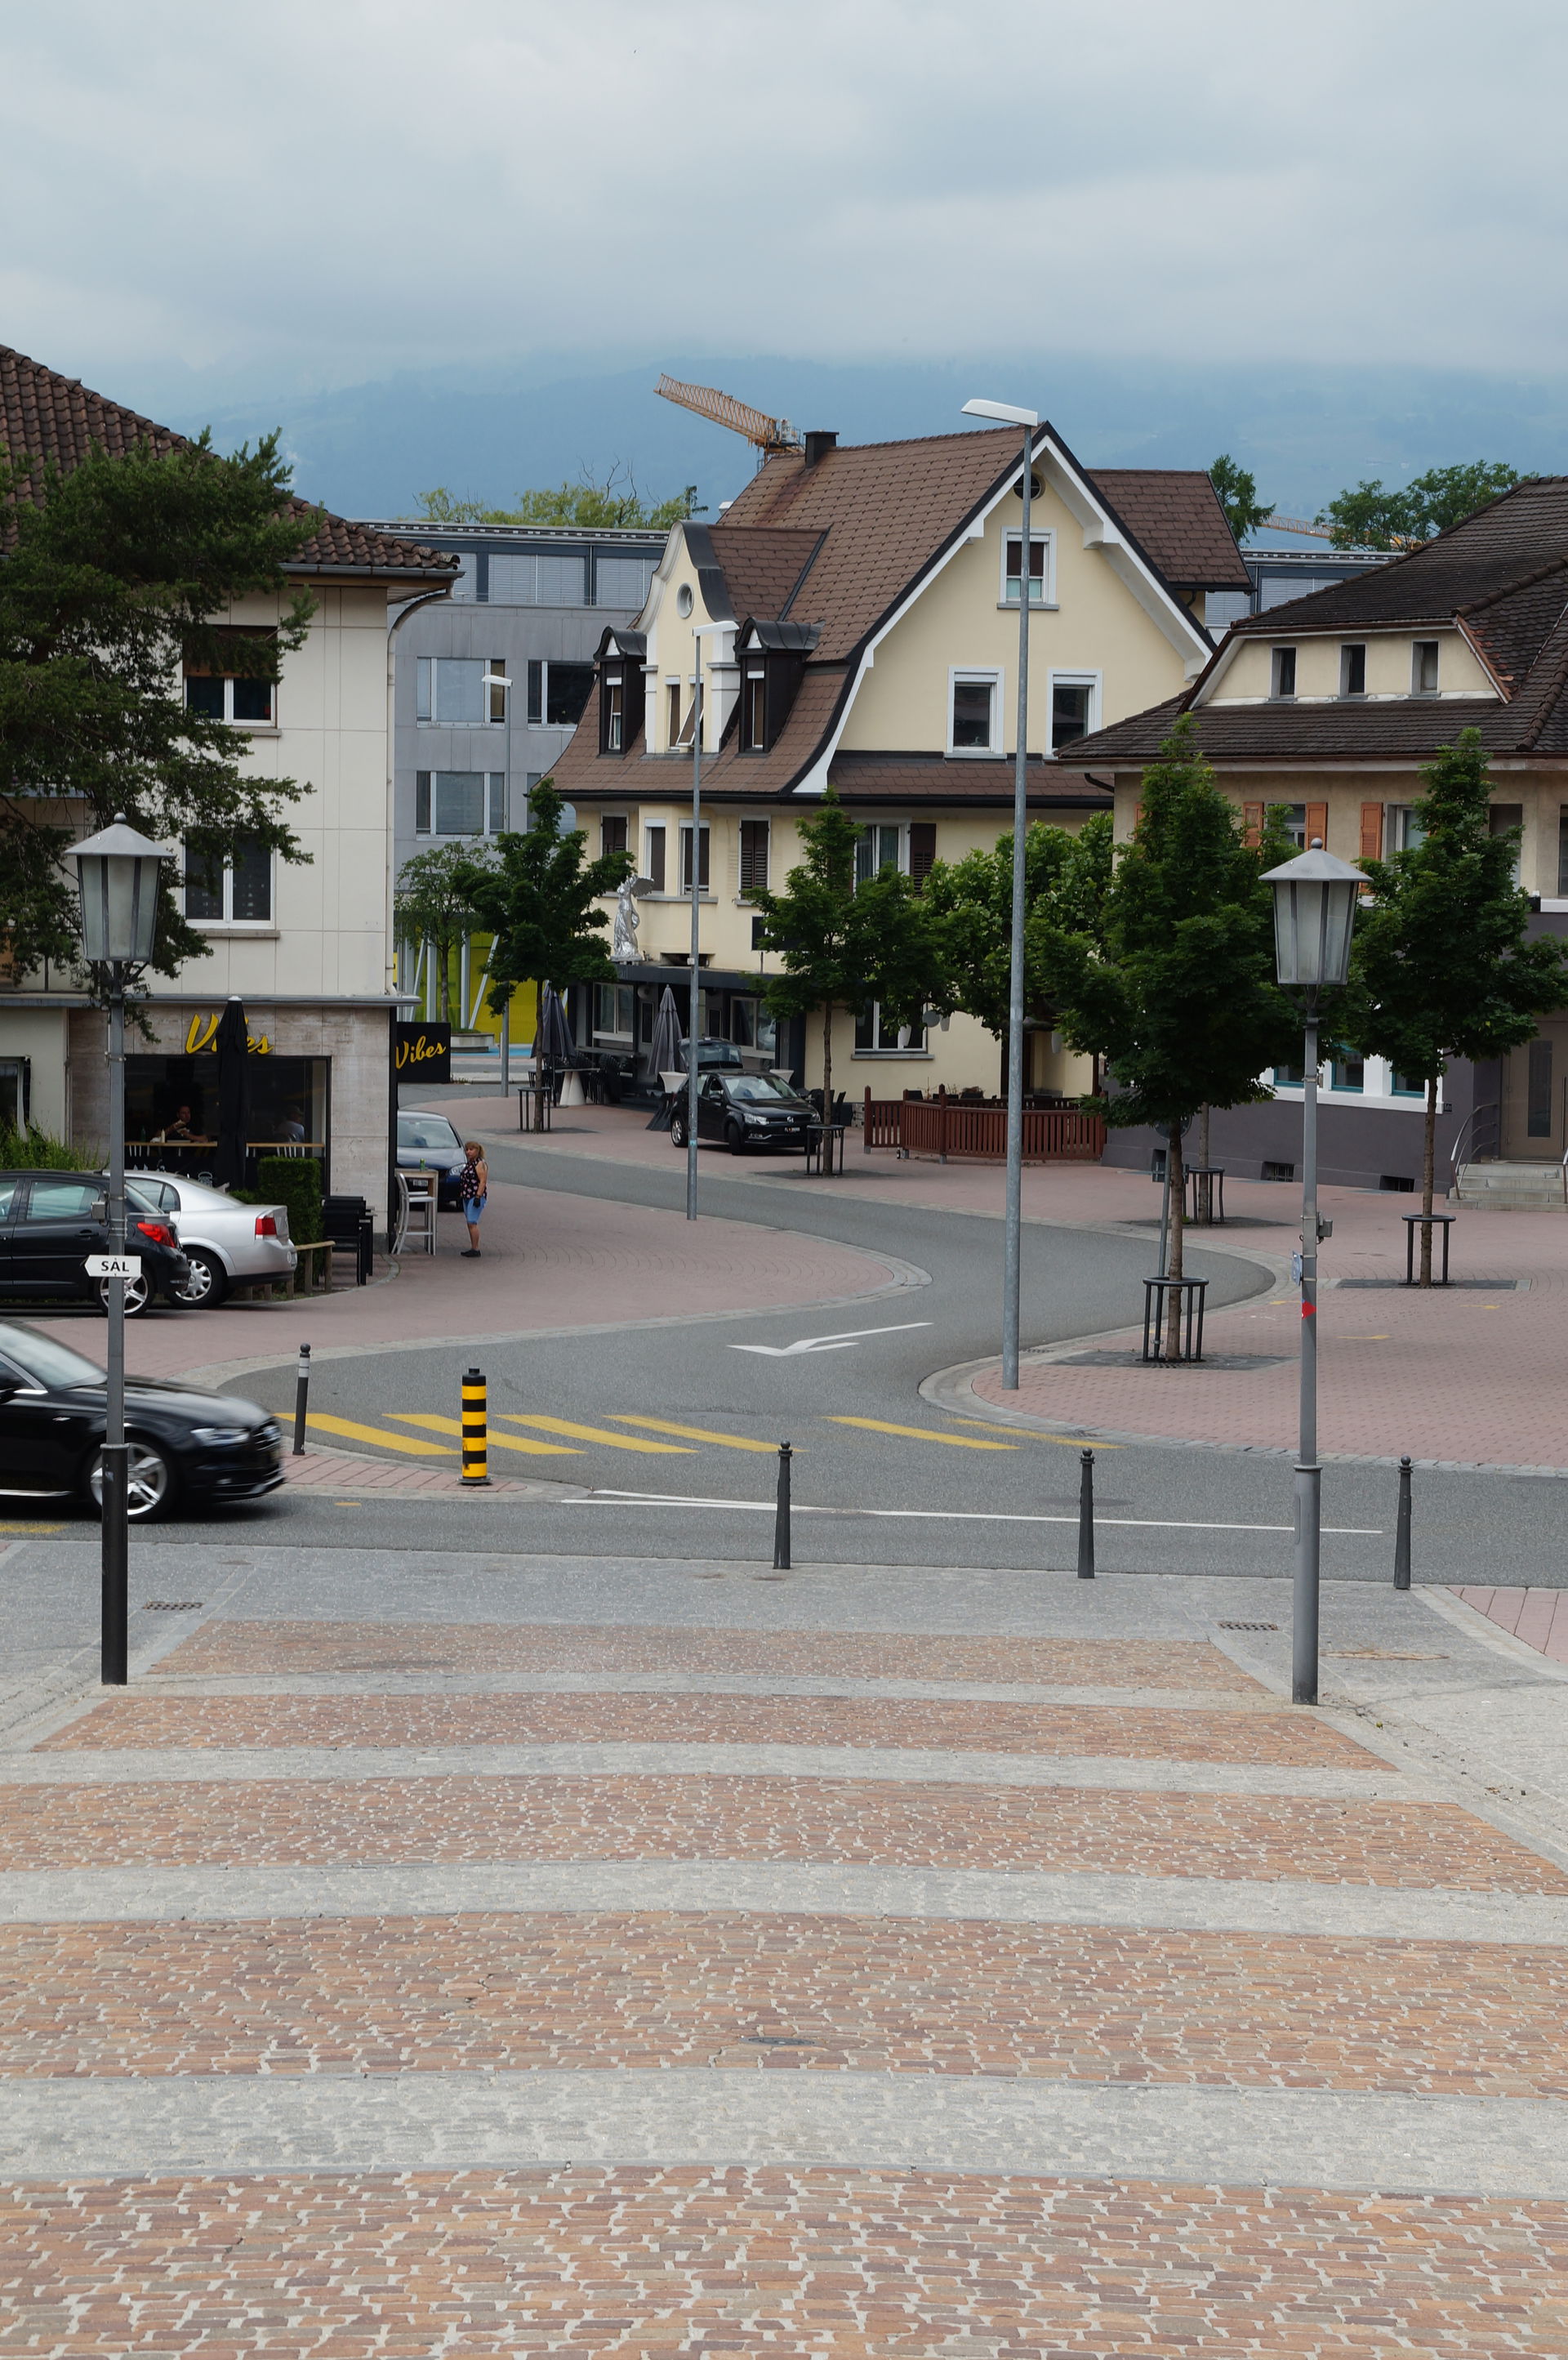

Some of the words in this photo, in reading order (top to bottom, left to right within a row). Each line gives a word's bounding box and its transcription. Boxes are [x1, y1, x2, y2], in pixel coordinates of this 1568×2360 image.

[185, 1013, 274, 1055] Ves
[395, 1035, 447, 1069] Vibes
[100, 1260, 130, 1272] SAL
